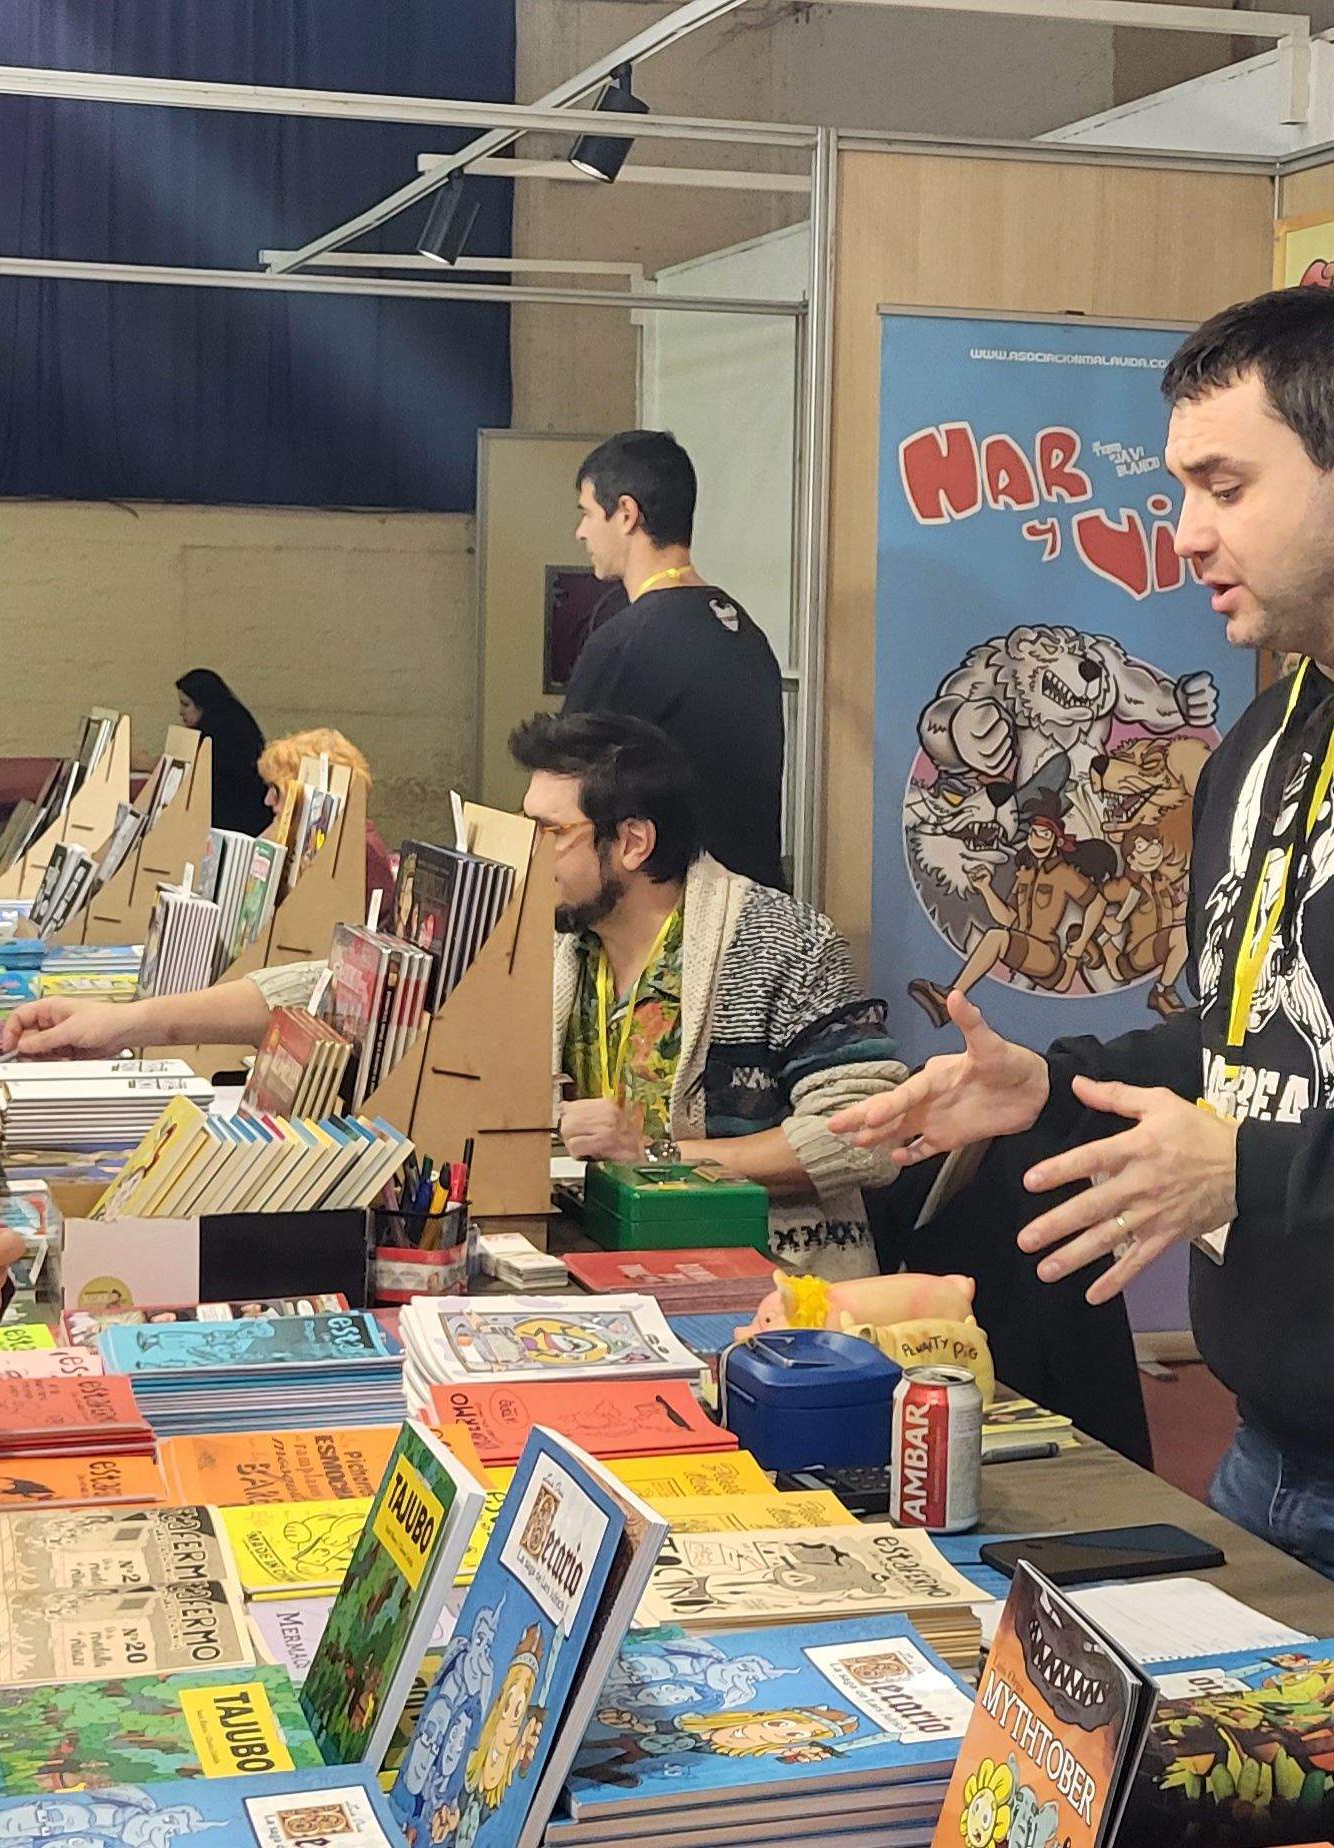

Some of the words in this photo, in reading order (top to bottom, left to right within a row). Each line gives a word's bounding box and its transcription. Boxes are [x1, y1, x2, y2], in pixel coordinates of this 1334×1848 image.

[387, 1471, 435, 1555] TAJUBO
[902, 1403, 931, 1522] AMBAR
[213, 1691, 276, 1772] TAJUBO
[982, 1669, 1096, 1828] MYTHTOBER
